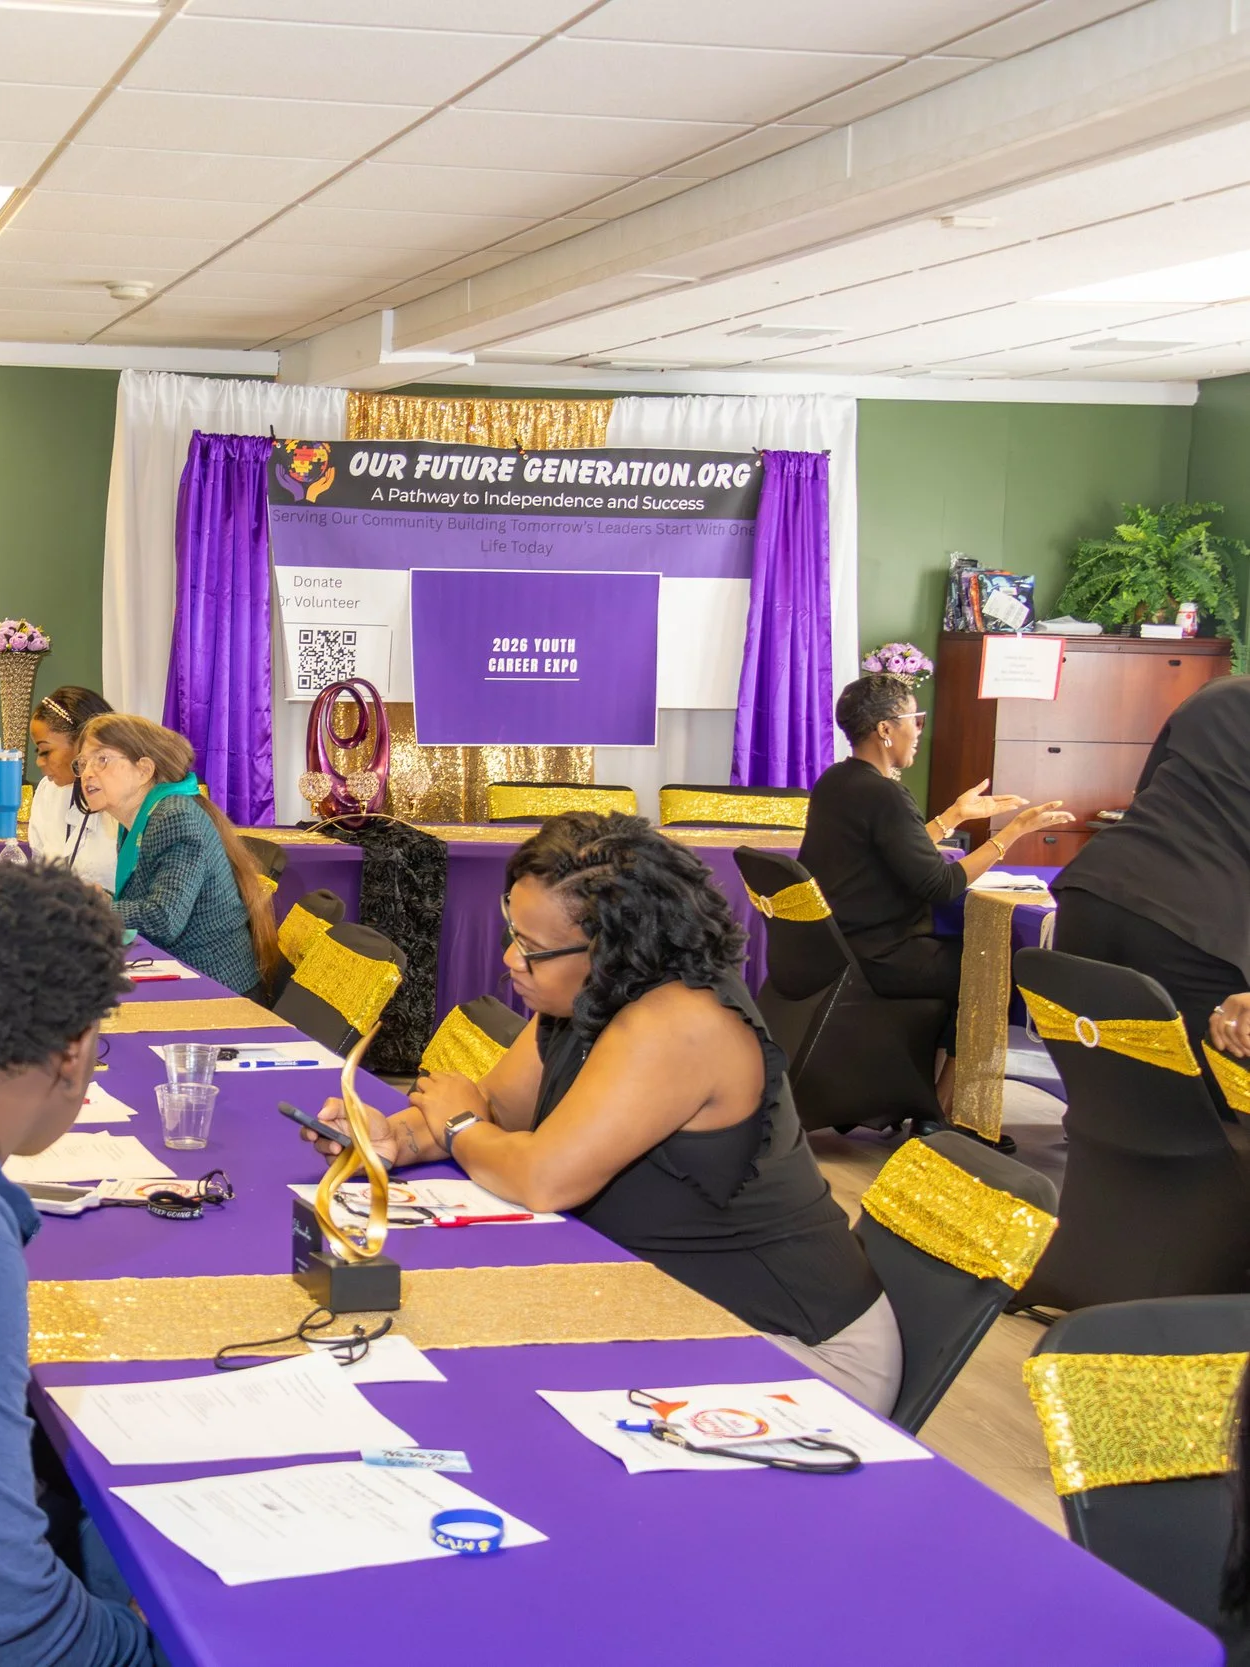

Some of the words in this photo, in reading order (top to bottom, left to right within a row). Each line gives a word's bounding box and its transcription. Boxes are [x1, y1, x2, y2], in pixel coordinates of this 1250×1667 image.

[349, 450, 407, 480] OUR
[414, 454, 516, 482] FUTURE
[523, 457, 751, 489] GENERATION.ORG
[371, 488, 384, 501] A
[388, 488, 459, 507] Pathway
[463, 491, 479, 504] to
[484, 491, 603, 509] Independence
[607, 495, 639, 510] and
[642, 496, 705, 511] Success
[273, 509, 327, 527] Serving
[331, 511, 358, 525] Our
[362, 513, 443, 532] Community
[448, 516, 506, 534] Building
[511, 519, 594, 534] Tomorrow's
[597, 521, 652, 535] Leaders
[656, 522, 692, 536] Start
[696, 522, 725, 536] With
[480, 539, 507, 553] Life
[511, 540, 554, 557] Today
[293, 575, 343, 588] Donate
[294, 596, 361, 609] Volunteer
[492, 637, 529, 653] 2026
[534, 638, 576, 653] YOUTH
[488, 657, 539, 673] CAREER
[544, 658, 578, 673] EXPO
